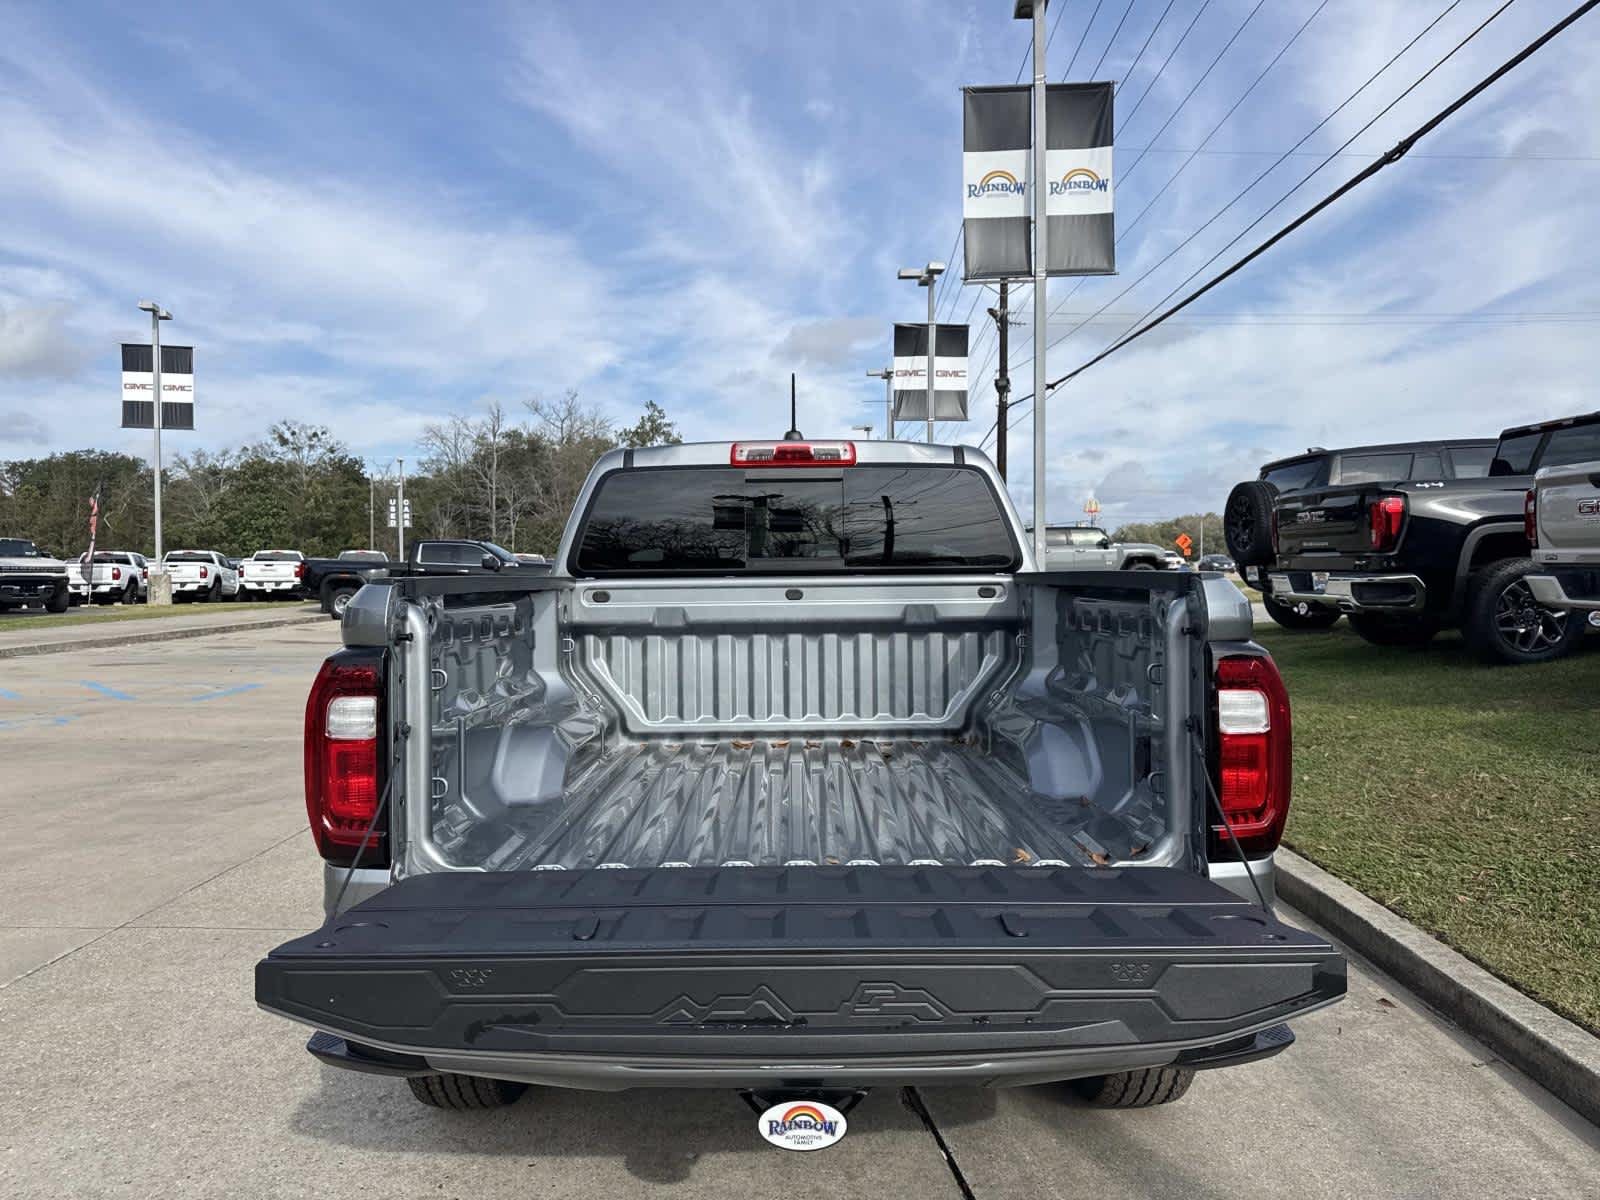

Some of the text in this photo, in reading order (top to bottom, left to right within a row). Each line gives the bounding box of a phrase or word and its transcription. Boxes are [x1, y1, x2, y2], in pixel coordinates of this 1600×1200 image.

[968, 182, 1026, 198] RAINBOW
[1050, 178, 1109, 195] RAINBOW
[896, 369, 926, 377] GMC
[936, 369, 967, 378] GMC
[123, 383, 153, 391] GMC
[162, 384, 192, 392] GMC
[389, 498, 397, 527] USED
[768, 1119, 839, 1137] RAINBOW
